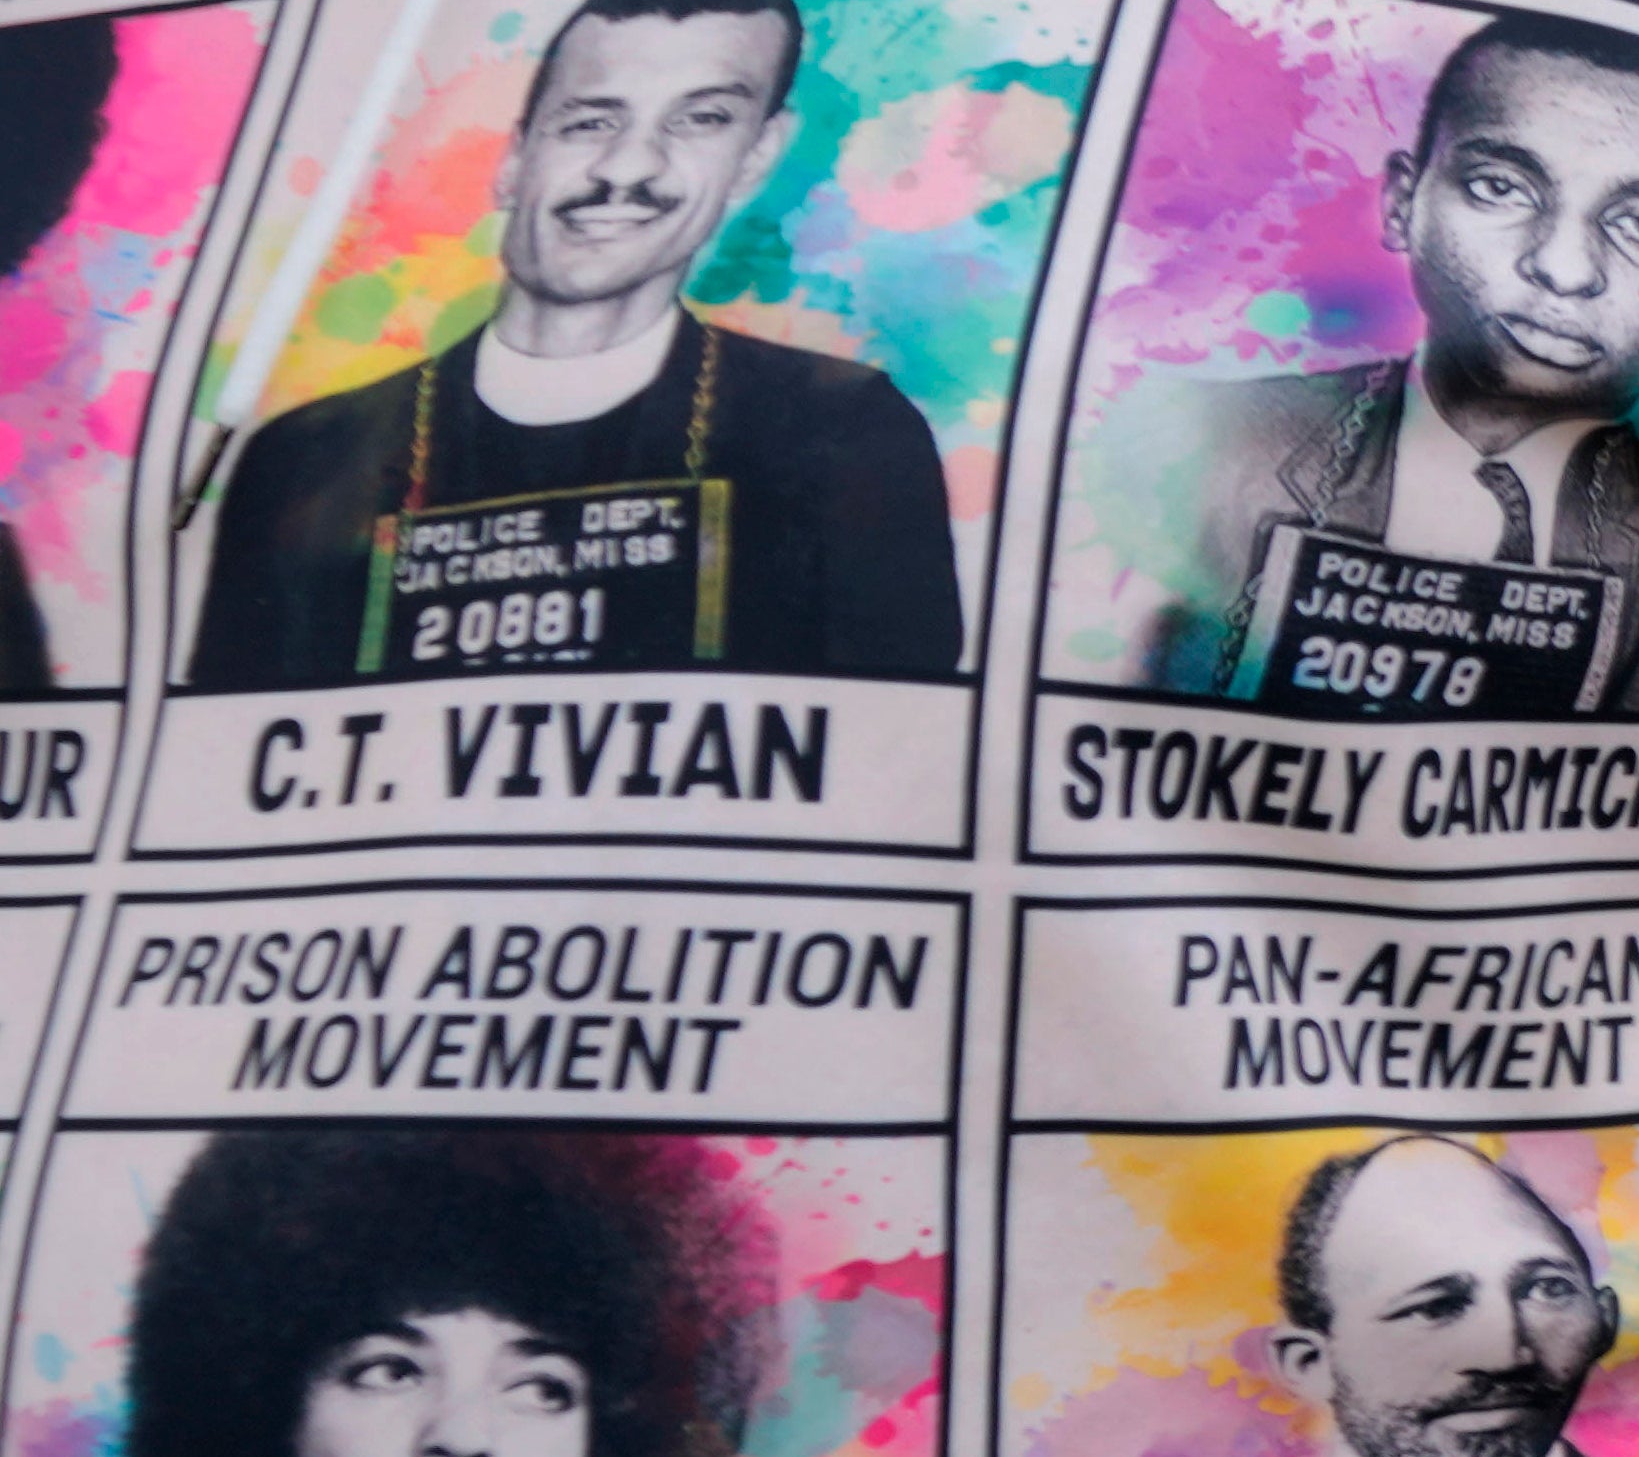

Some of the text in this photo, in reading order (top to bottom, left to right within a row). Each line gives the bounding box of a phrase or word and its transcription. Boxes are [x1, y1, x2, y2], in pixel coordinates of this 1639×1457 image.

[410, 496, 688, 557] POLICE DEPT.
[1293, 585, 1580, 651] JACKSON, MISS
[1315, 550, 1591, 621] POLICE DEPT.
[409, 588, 605, 663] 20881
[1291, 634, 1487, 710] 20978
[247, 700, 830, 815] C.T. VIVIAN
[1060, 721, 1386, 837] STOKELY
[116, 925, 930, 1011] PRISON ABOLITION
[228, 1013, 742, 1094] MOVEMENT
[1221, 1013, 1636, 1094] MOVEMENT
